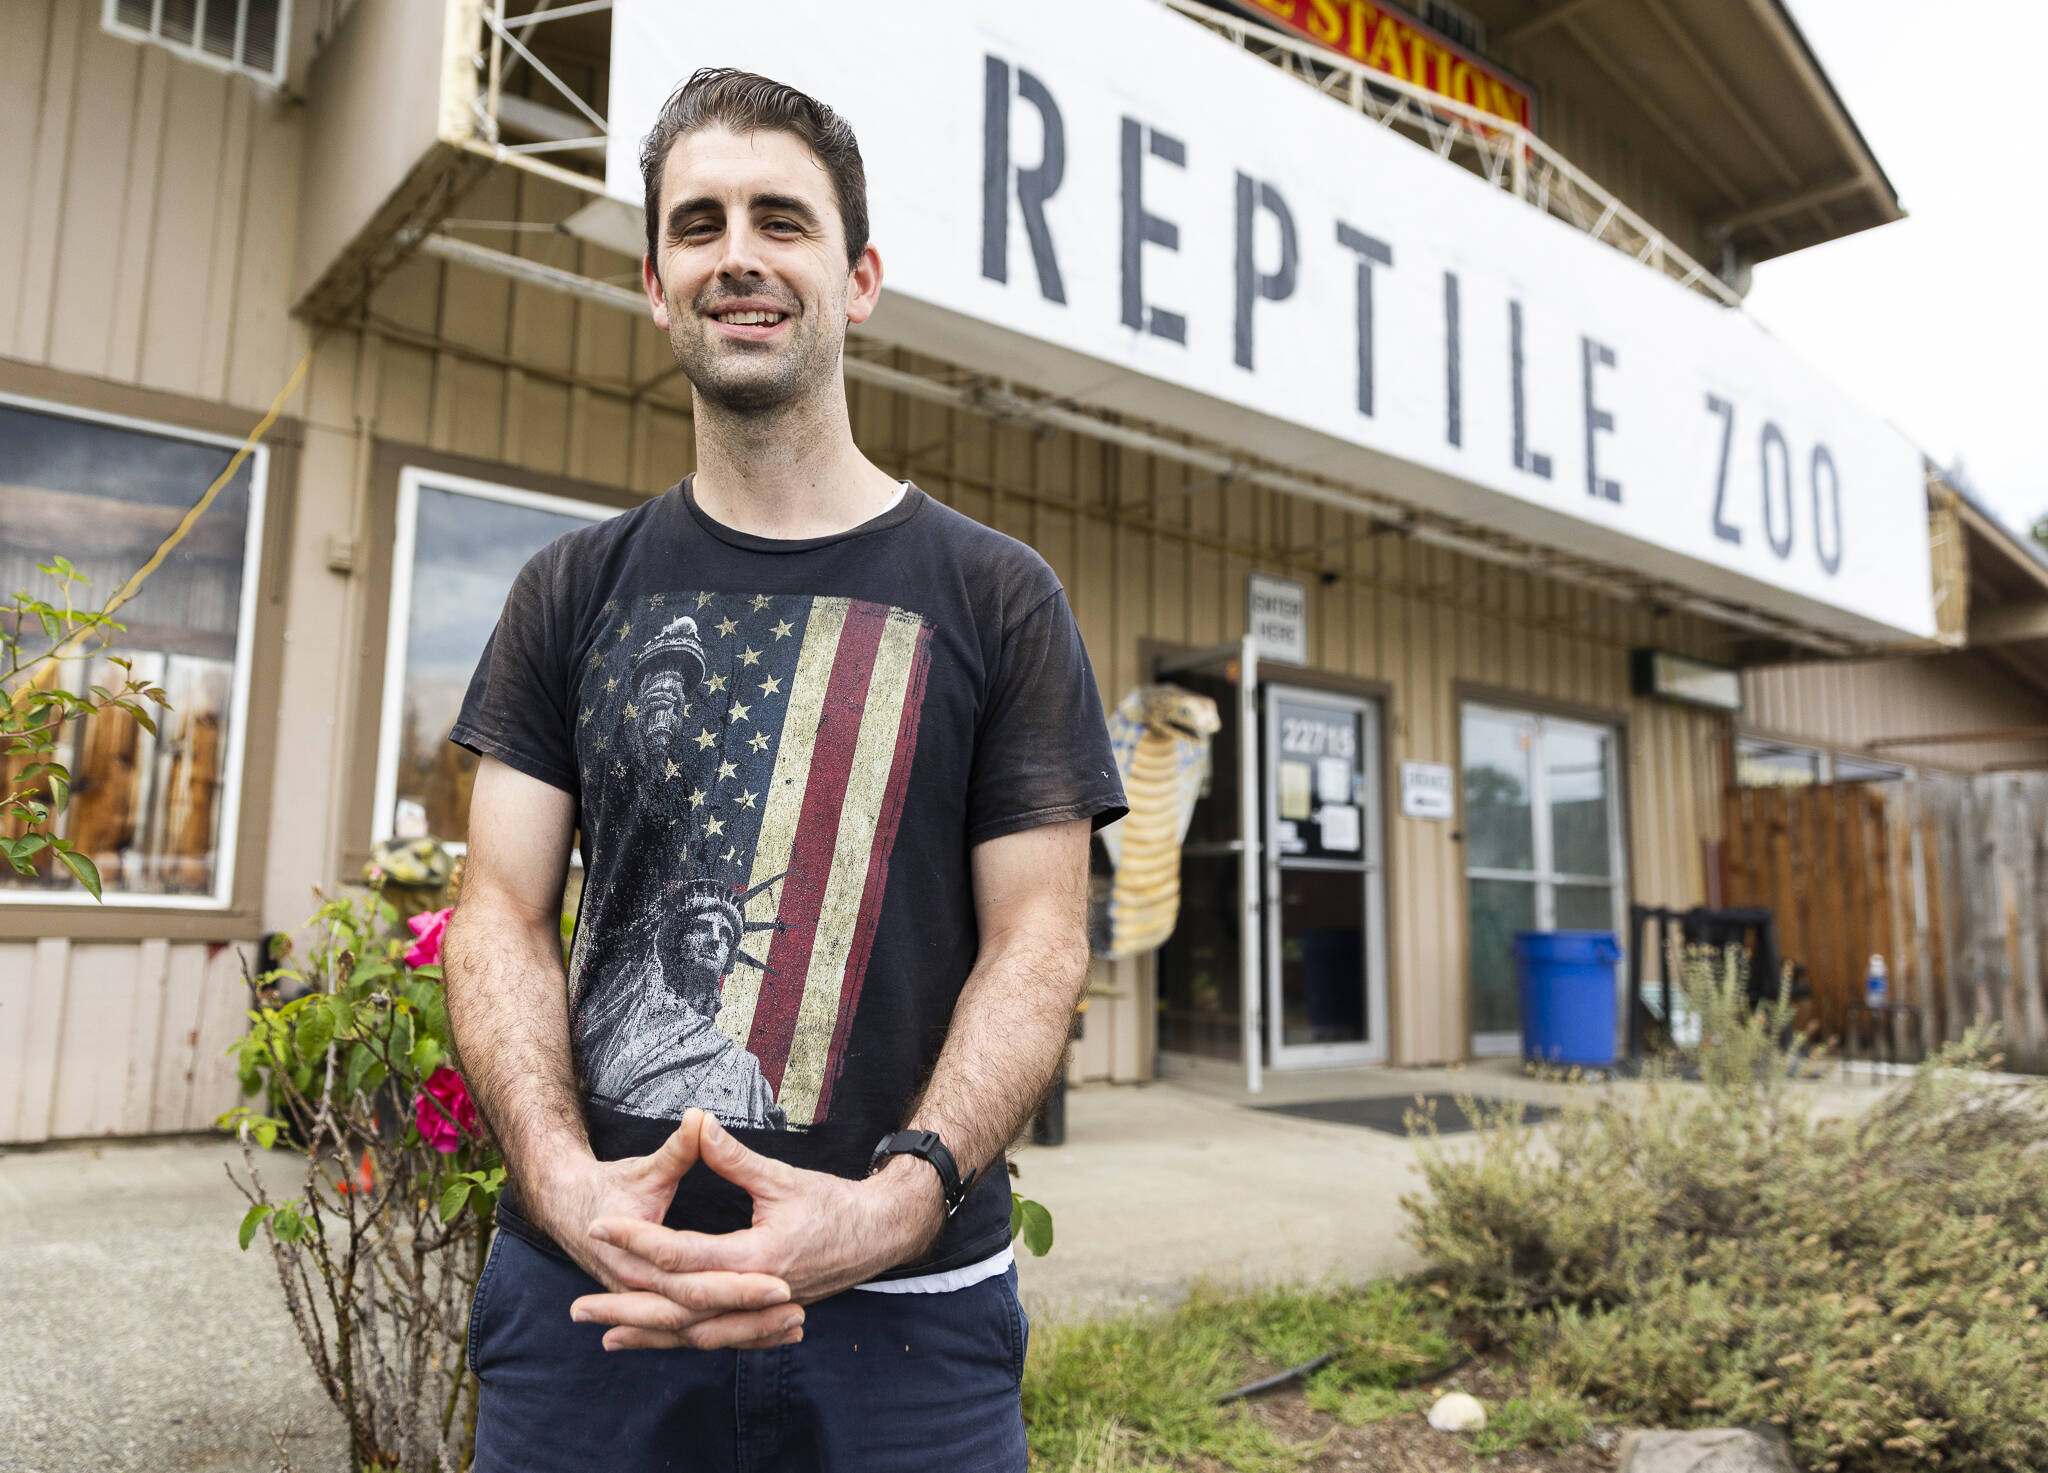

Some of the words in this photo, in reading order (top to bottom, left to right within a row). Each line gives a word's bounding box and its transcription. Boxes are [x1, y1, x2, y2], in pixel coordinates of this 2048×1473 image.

[1307, 0, 1522, 136] STATION
[982, 54, 1622, 504] REPTILE
[1705, 391, 1842, 576] ZOO
[1282, 718, 1355, 757] 22715
